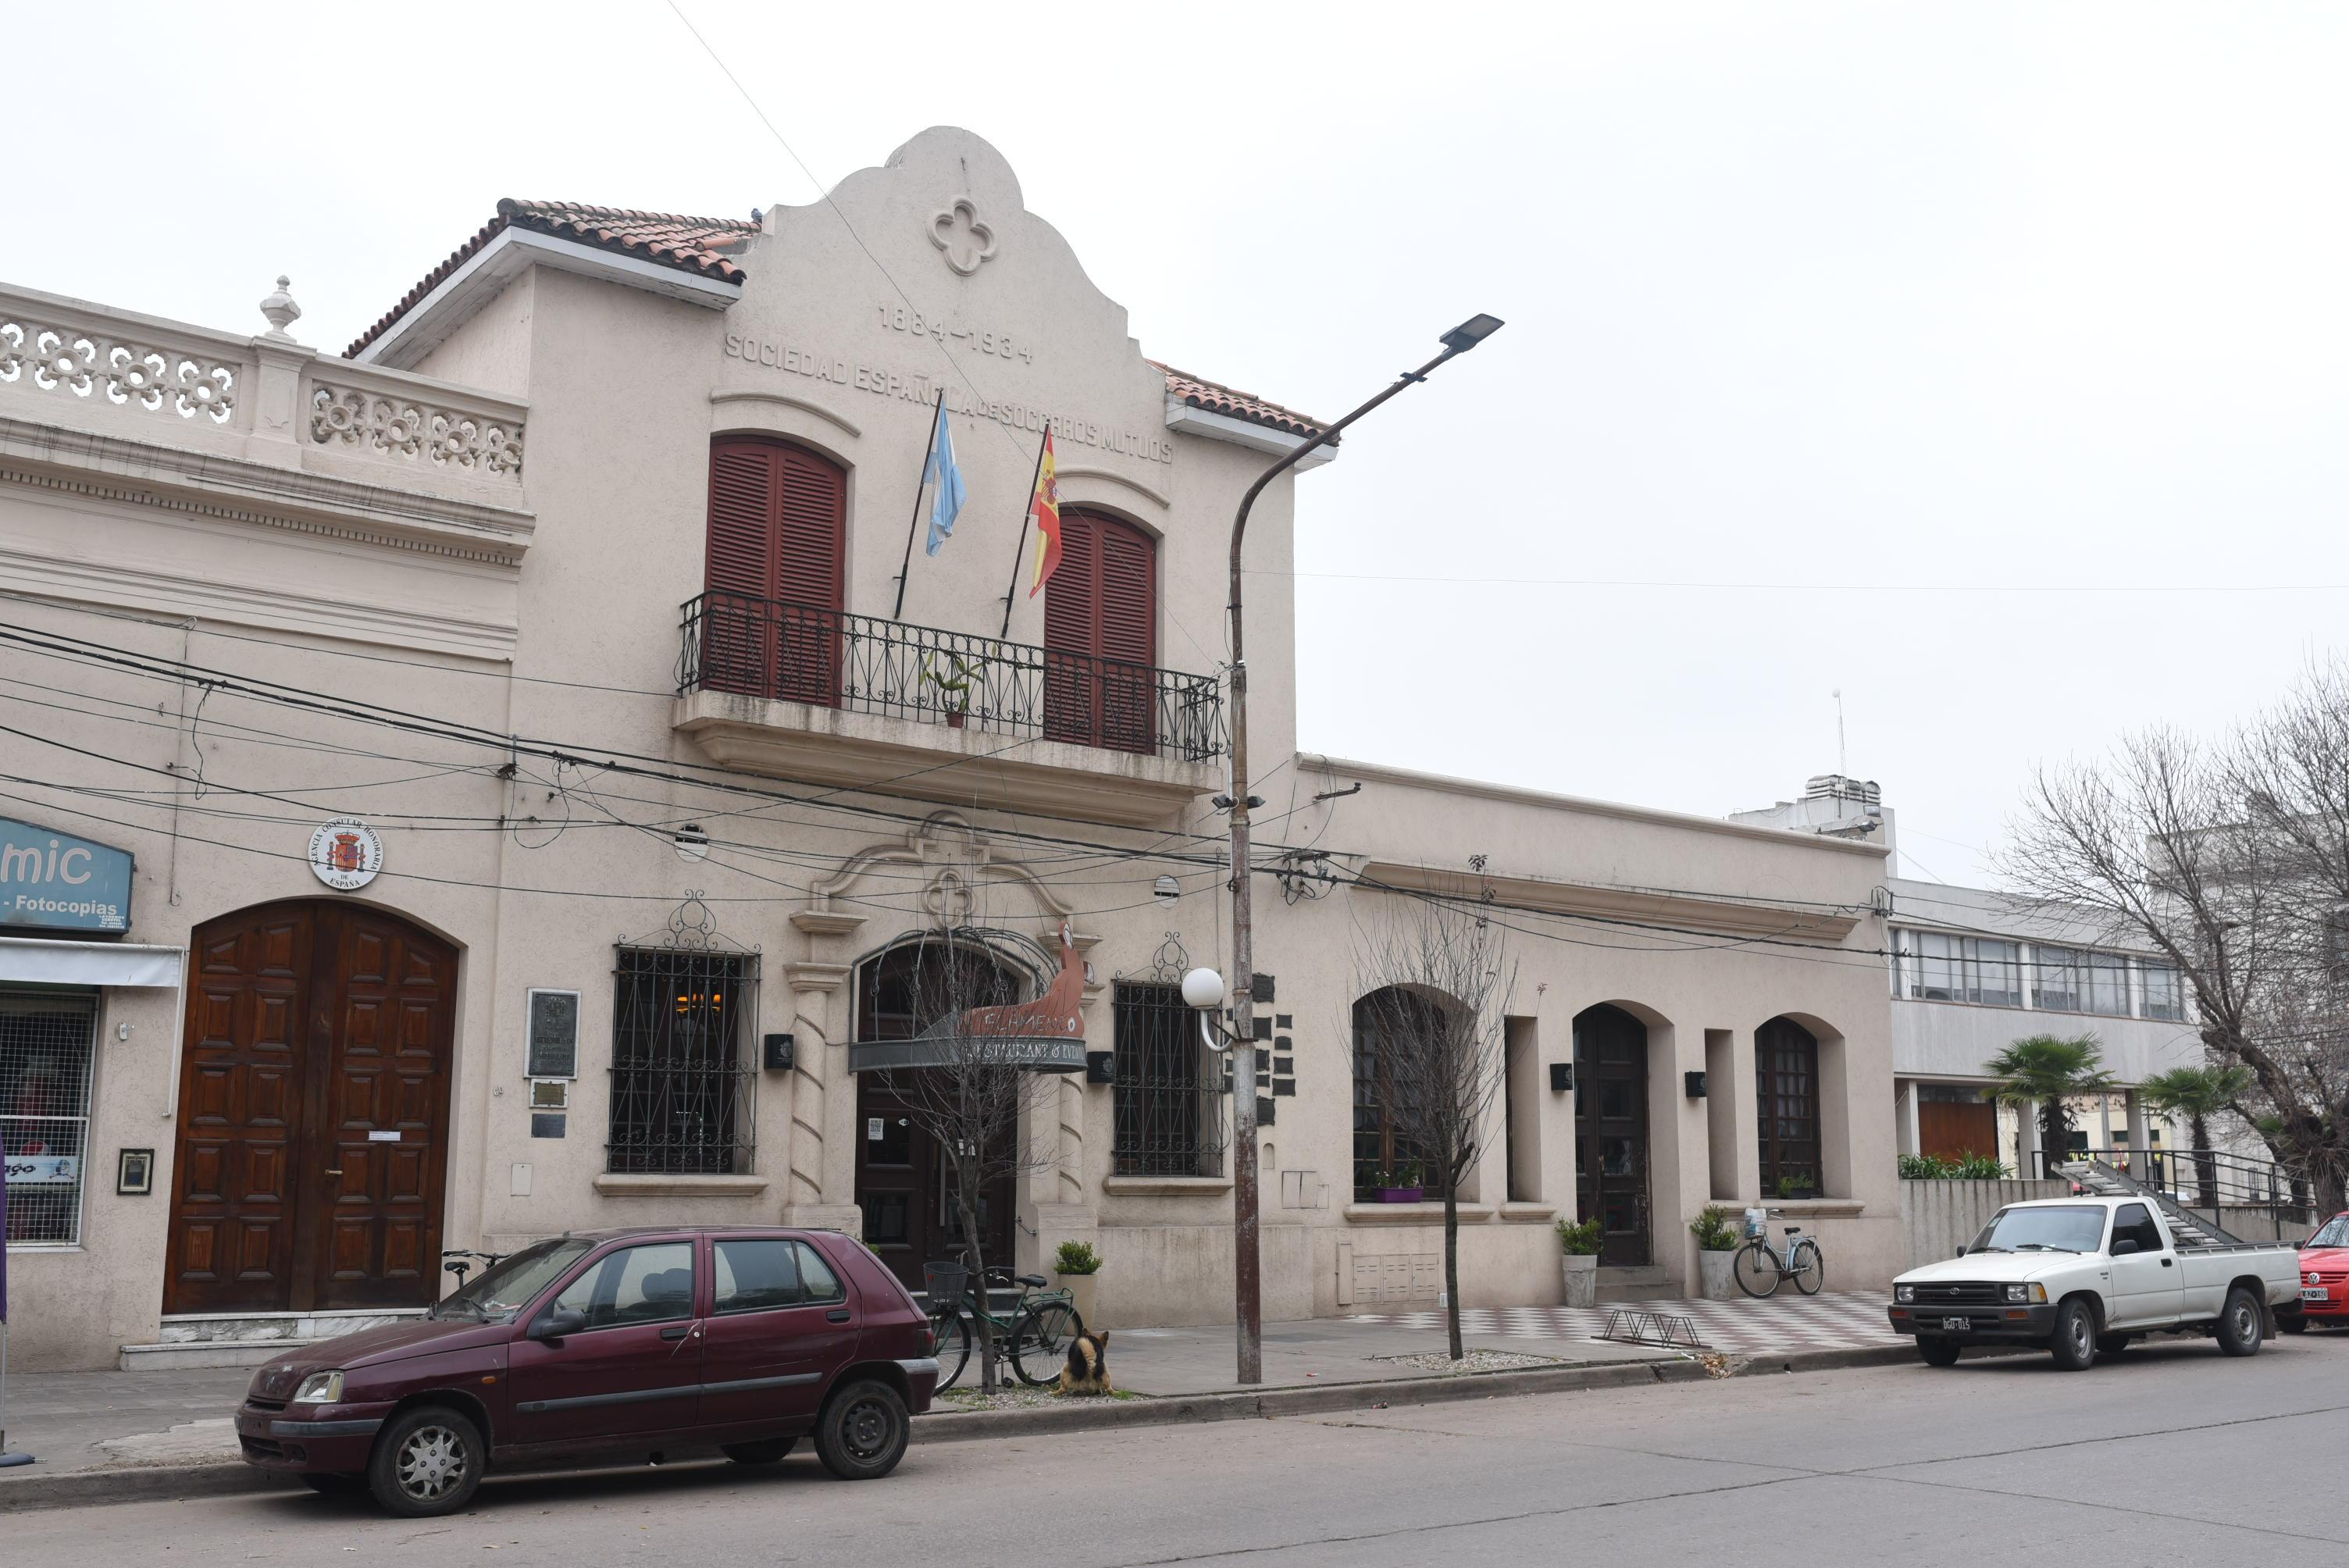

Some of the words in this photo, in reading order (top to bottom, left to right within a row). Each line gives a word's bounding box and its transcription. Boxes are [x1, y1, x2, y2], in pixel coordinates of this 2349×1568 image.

[725, 332, 848, 384] SOCIEDAD
[854, 364, 975, 417] ESPAÑOLA
[976, 398, 998, 419] DE
[1000, 401, 1097, 447] SOCORROS
[1100, 426, 1172, 465] MUTUOS
[311, 834, 323, 866] AGENCIA
[322, 818, 362, 832] CONSULAR
[363, 826, 381, 870] HONORARIA
[330, 878, 361, 888] ESPAÑA
[15, 895, 117, 918] Fotocopias
[1051, 1044, 1060, 1058] &
